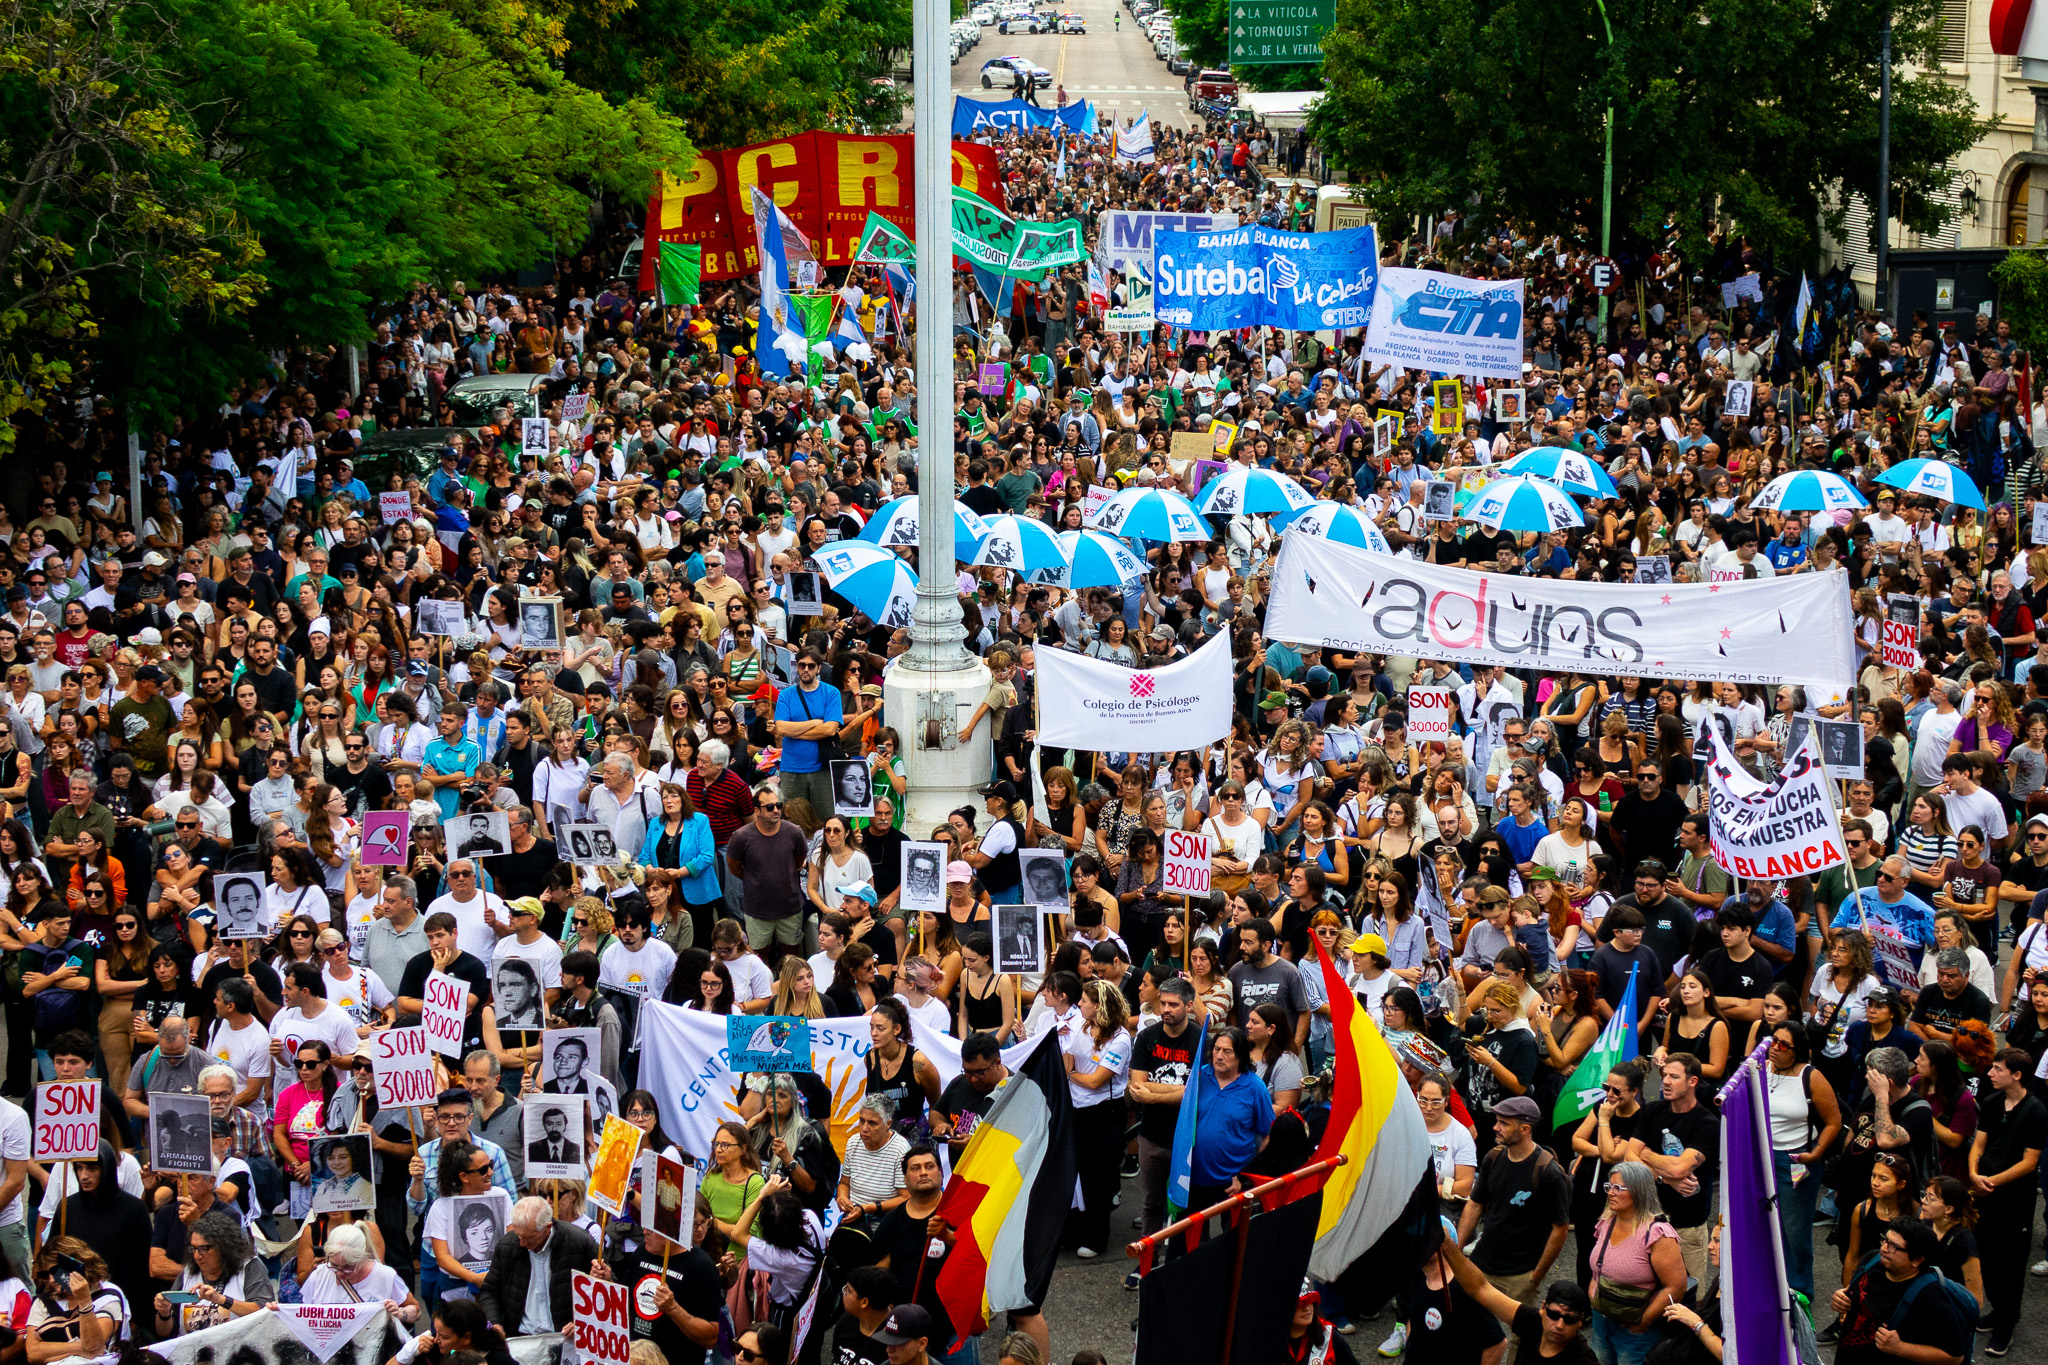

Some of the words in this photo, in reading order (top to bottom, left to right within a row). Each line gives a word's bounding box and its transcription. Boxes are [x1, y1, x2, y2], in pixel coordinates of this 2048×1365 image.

[1248, 8, 1261, 19] LA
[1268, 6, 1318, 18] VITICOLA
[1248, 25, 1308, 37] TORNQUIST
[1262, 45, 1272, 55] DE
[1276, 44, 1287, 55] LA
[1292, 44, 1325, 55] VENTAN
[1338, 217, 1360, 228] PATIO
[1198, 231, 1249, 249] BAHÍA
[1253, 231, 1310, 250] BLANCA
[1158, 254, 1265, 297] Suteba
[1594, 265, 1610, 288] E
[1293, 281, 1314, 306] LA
[1425, 278, 1480, 300] Buenos
[1482, 288, 1515, 302] Aires
[1389, 331, 1409, 339] Central
[1418, 335, 1450, 345] Trabajadores
[1385, 342, 1422, 354] REGIONAL
[1423, 348, 1460, 358] VILLARINO
[1481, 355, 1508, 363] ROSALES
[1392, 351, 1421, 361] BLANCA
[1426, 356, 1460, 366] DORREGO
[1465, 361, 1488, 369] MONTE
[1488, 363, 1519, 372] HERMOSO
[565, 396, 586, 407] SON
[1922, 473, 1946, 488] JP
[1828, 486, 1847, 501] JP
[1482, 499, 1501, 515] JP
[1174, 515, 1193, 532] JP
[1778, 554, 1789, 566] 10
[1372, 577, 1644, 663] aduns
[1884, 620, 1916, 649] SON
[1083, 699, 1125, 712] Colegio
[1128, 699, 1142, 710] de
[1145, 695, 1200, 709] Psicólogos
[1409, 691, 1449, 708] SON
[1768, 782, 1822, 819] LUCHA
[1749, 807, 1829, 848] NUESTRA
[1168, 831, 1208, 861] SON
[1733, 839, 1843, 878] BLANCA
[426, 978, 462, 1012] SON
[1240, 983, 1280, 997] RIDE
[731, 1017, 745, 1031] 50
[732, 1024, 753, 1040] AÑOS
[377, 1029, 427, 1059] SON
[731, 1052, 749, 1064] Más
[750, 1055, 765, 1065] que
[756, 1062, 790, 1071] NUNCA
[792, 1059, 811, 1071] MÁS
[379, 1067, 436, 1106] 30.000
[680, 1047, 730, 1113] CENTR
[43, 1084, 96, 1117] SON
[36, 1122, 99, 1155] 30.000
[160, 1151, 205, 1162] ARMANDO
[168, 1160, 201, 1168] FIORITI
[573, 1274, 628, 1329] SON
[295, 1306, 356, 1320] JUBILADOS
[308, 1319, 318, 1328] EN
[319, 1320, 342, 1329] LUCHA
[574, 1319, 630, 1364] 30.000
